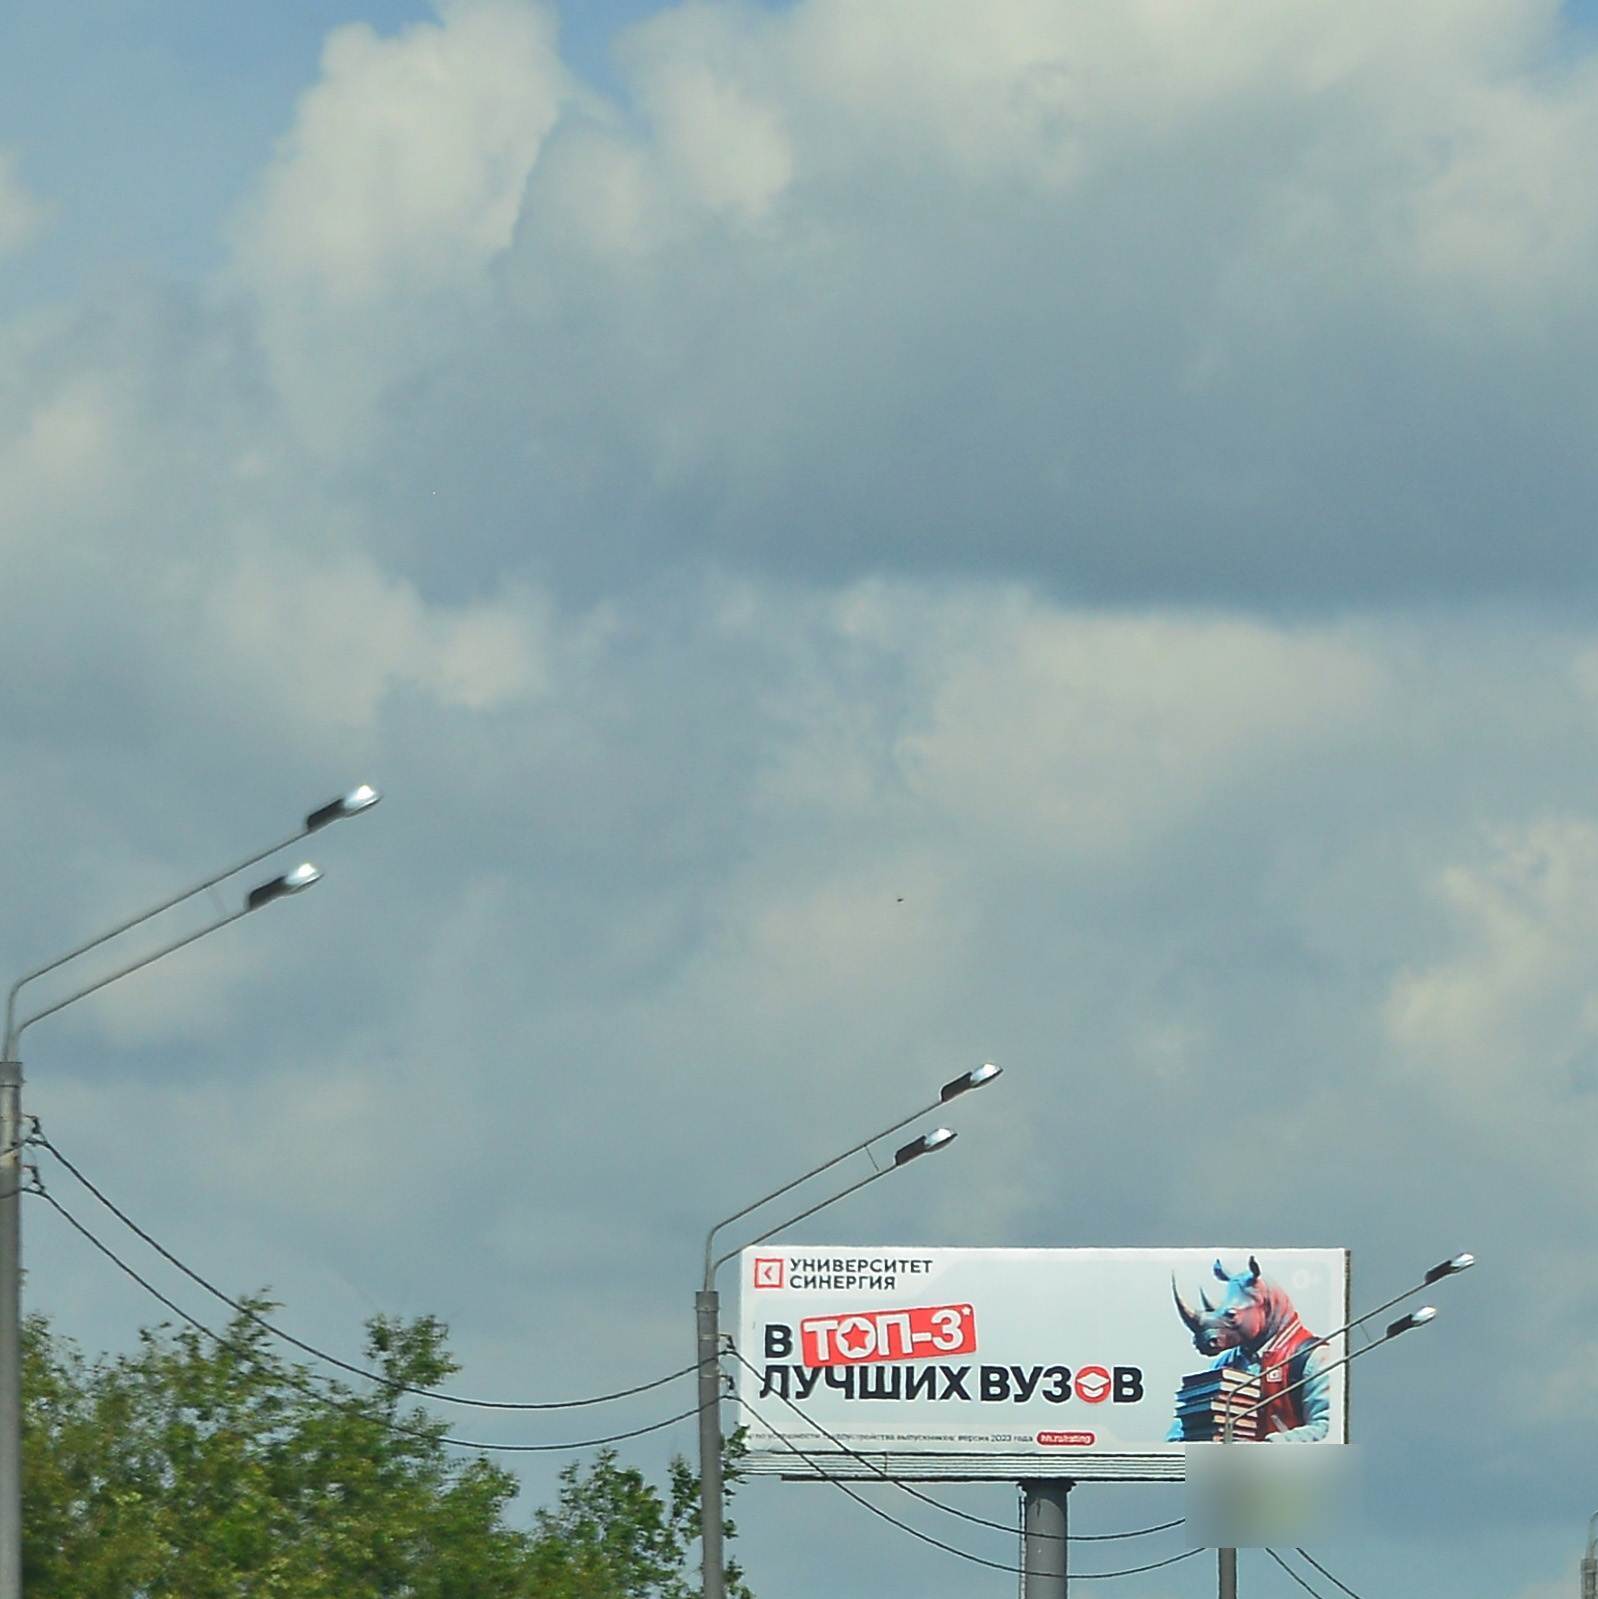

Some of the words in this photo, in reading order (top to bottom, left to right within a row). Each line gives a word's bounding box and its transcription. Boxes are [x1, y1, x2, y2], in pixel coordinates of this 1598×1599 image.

[789, 1258, 933, 1274] УНИВЕРСИТЕТ
[789, 1275, 896, 1290] СИНЕРГИЯ
[764, 1324, 793, 1359] В
[759, 1365, 971, 1401] ЛУЧШИХ
[980, 1364, 1145, 1403] ВУЗОВ
